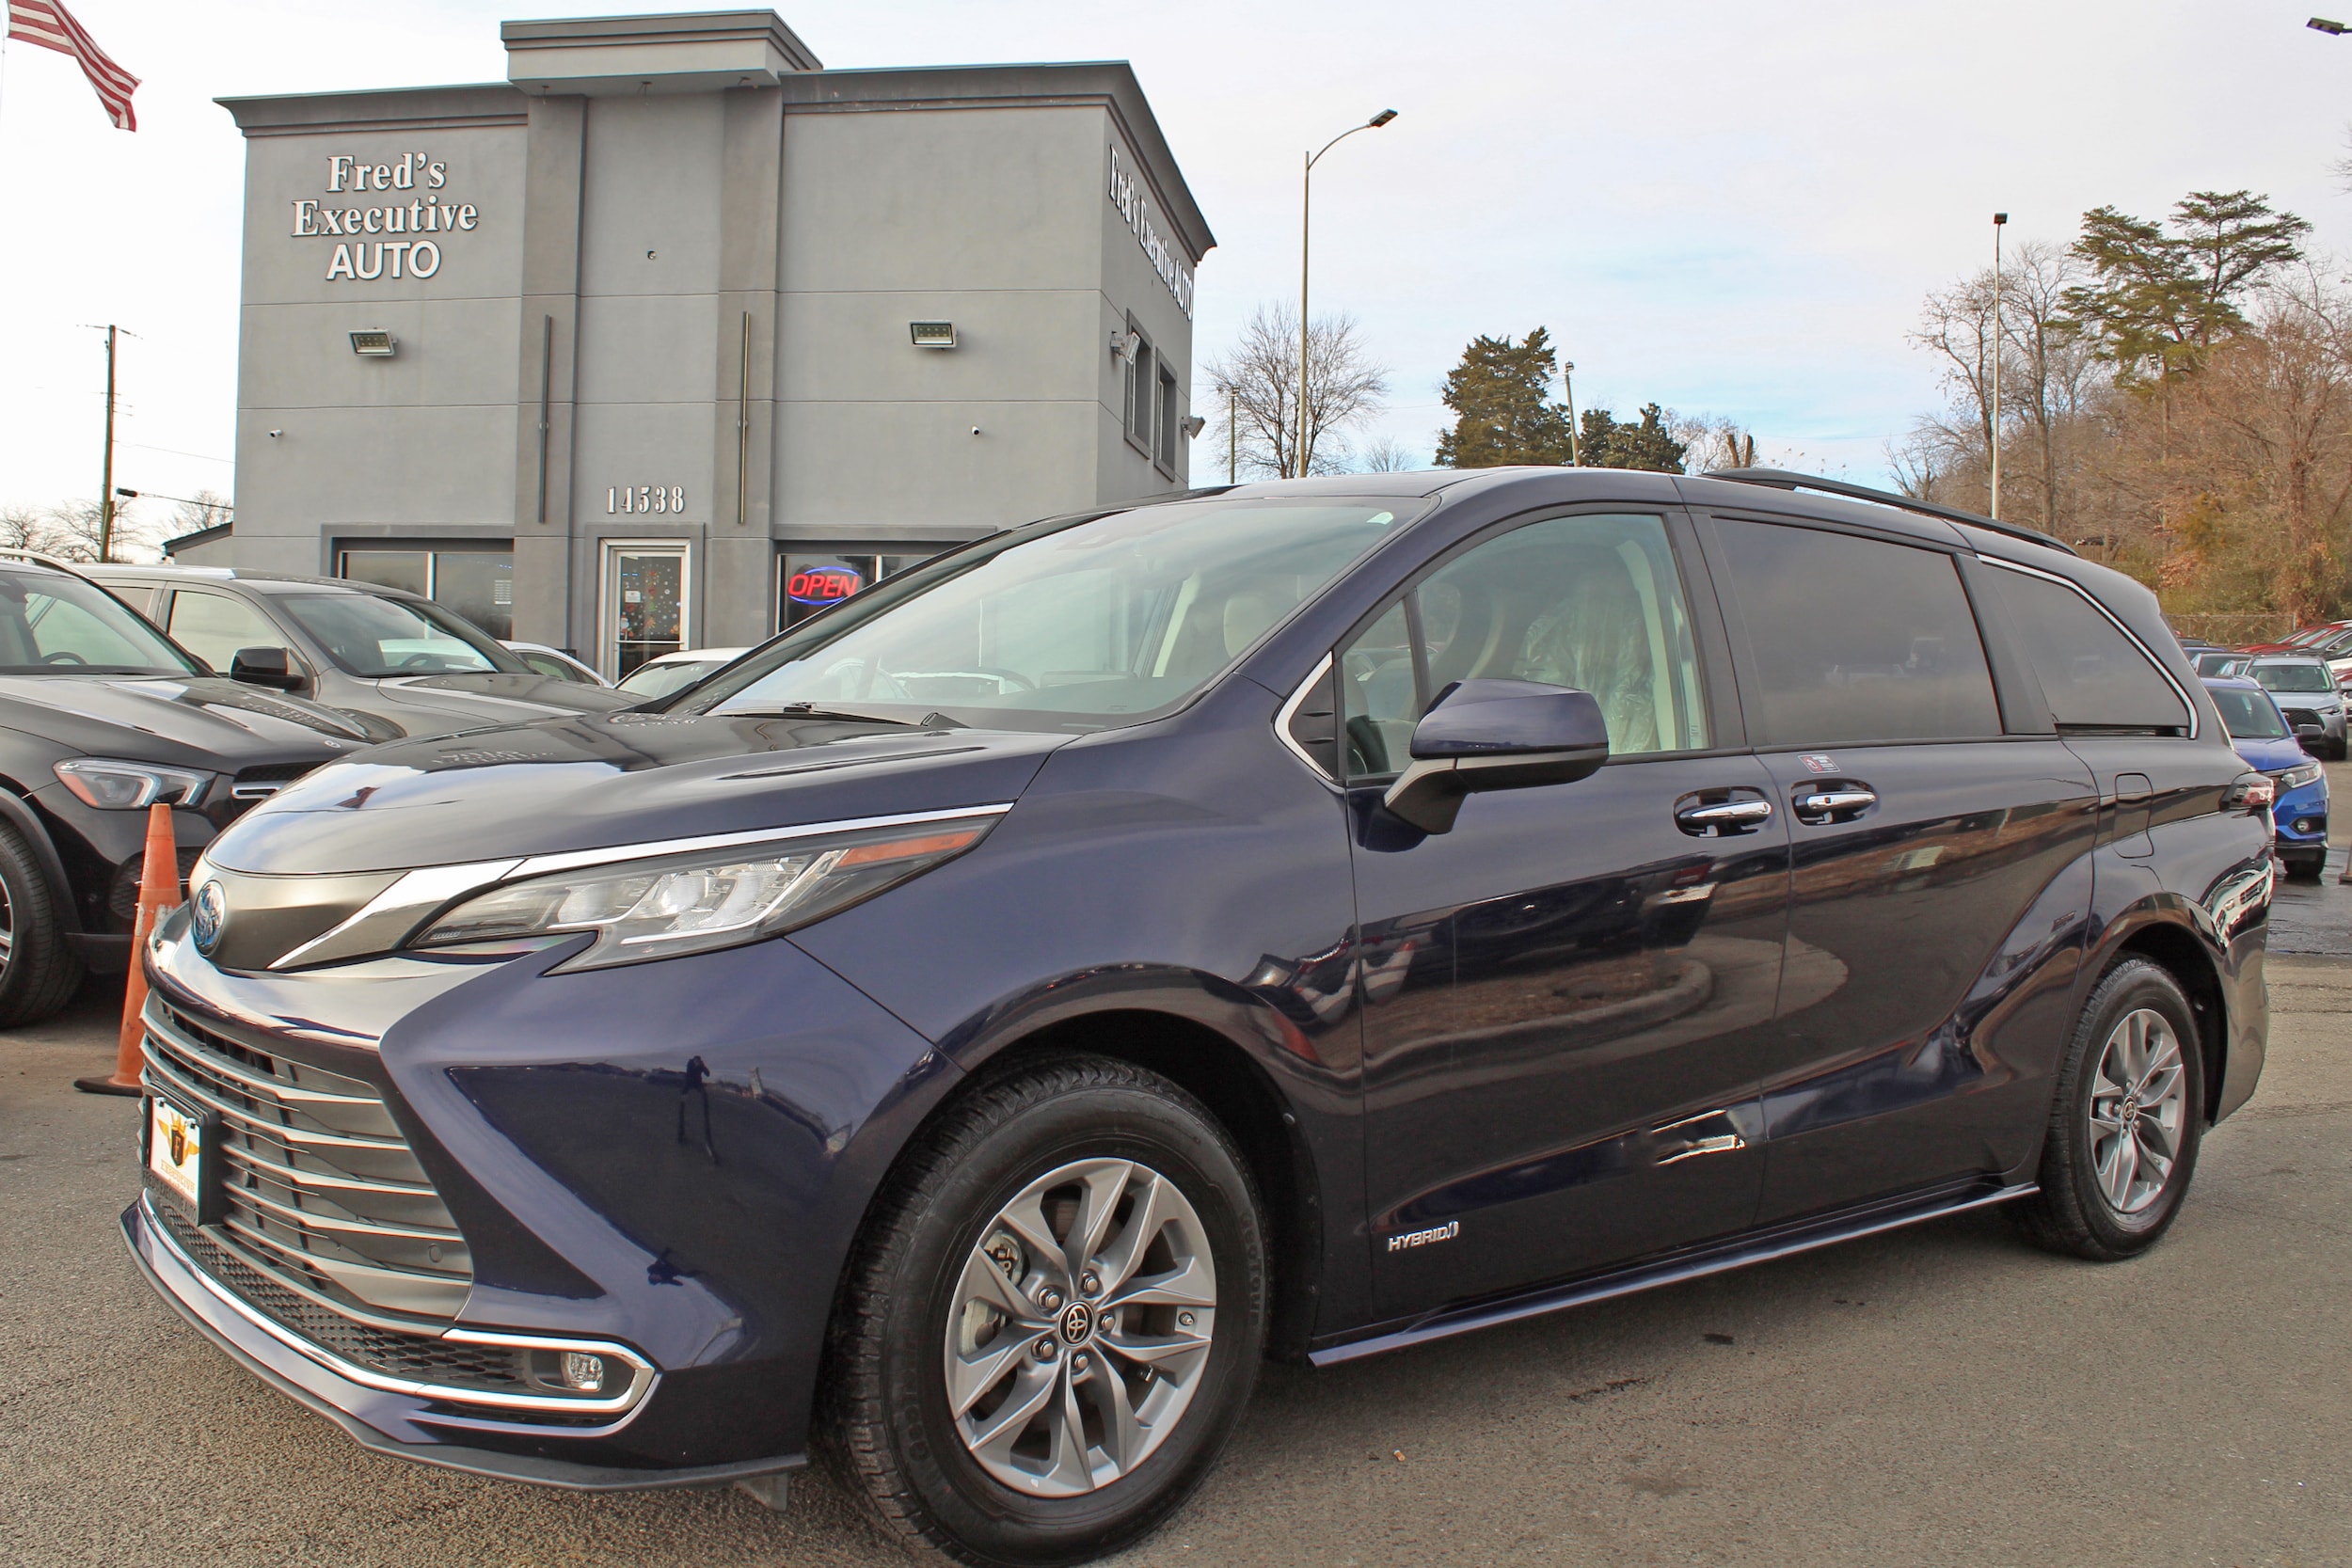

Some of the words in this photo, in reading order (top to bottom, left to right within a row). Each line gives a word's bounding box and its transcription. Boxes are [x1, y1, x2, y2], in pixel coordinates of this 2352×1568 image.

[326, 151, 447, 192] Fred's
[292, 195, 478, 236] Executive
[1109, 143, 1137, 234] Fred's
[1139, 195, 1174, 292] Executive
[1173, 259, 1193, 321] AUTO
[326, 240, 441, 280] AUTO
[607, 485, 685, 514] 14538
[787, 573, 859, 596] OPEN
[1388, 1226, 1449, 1251] HYBRID
